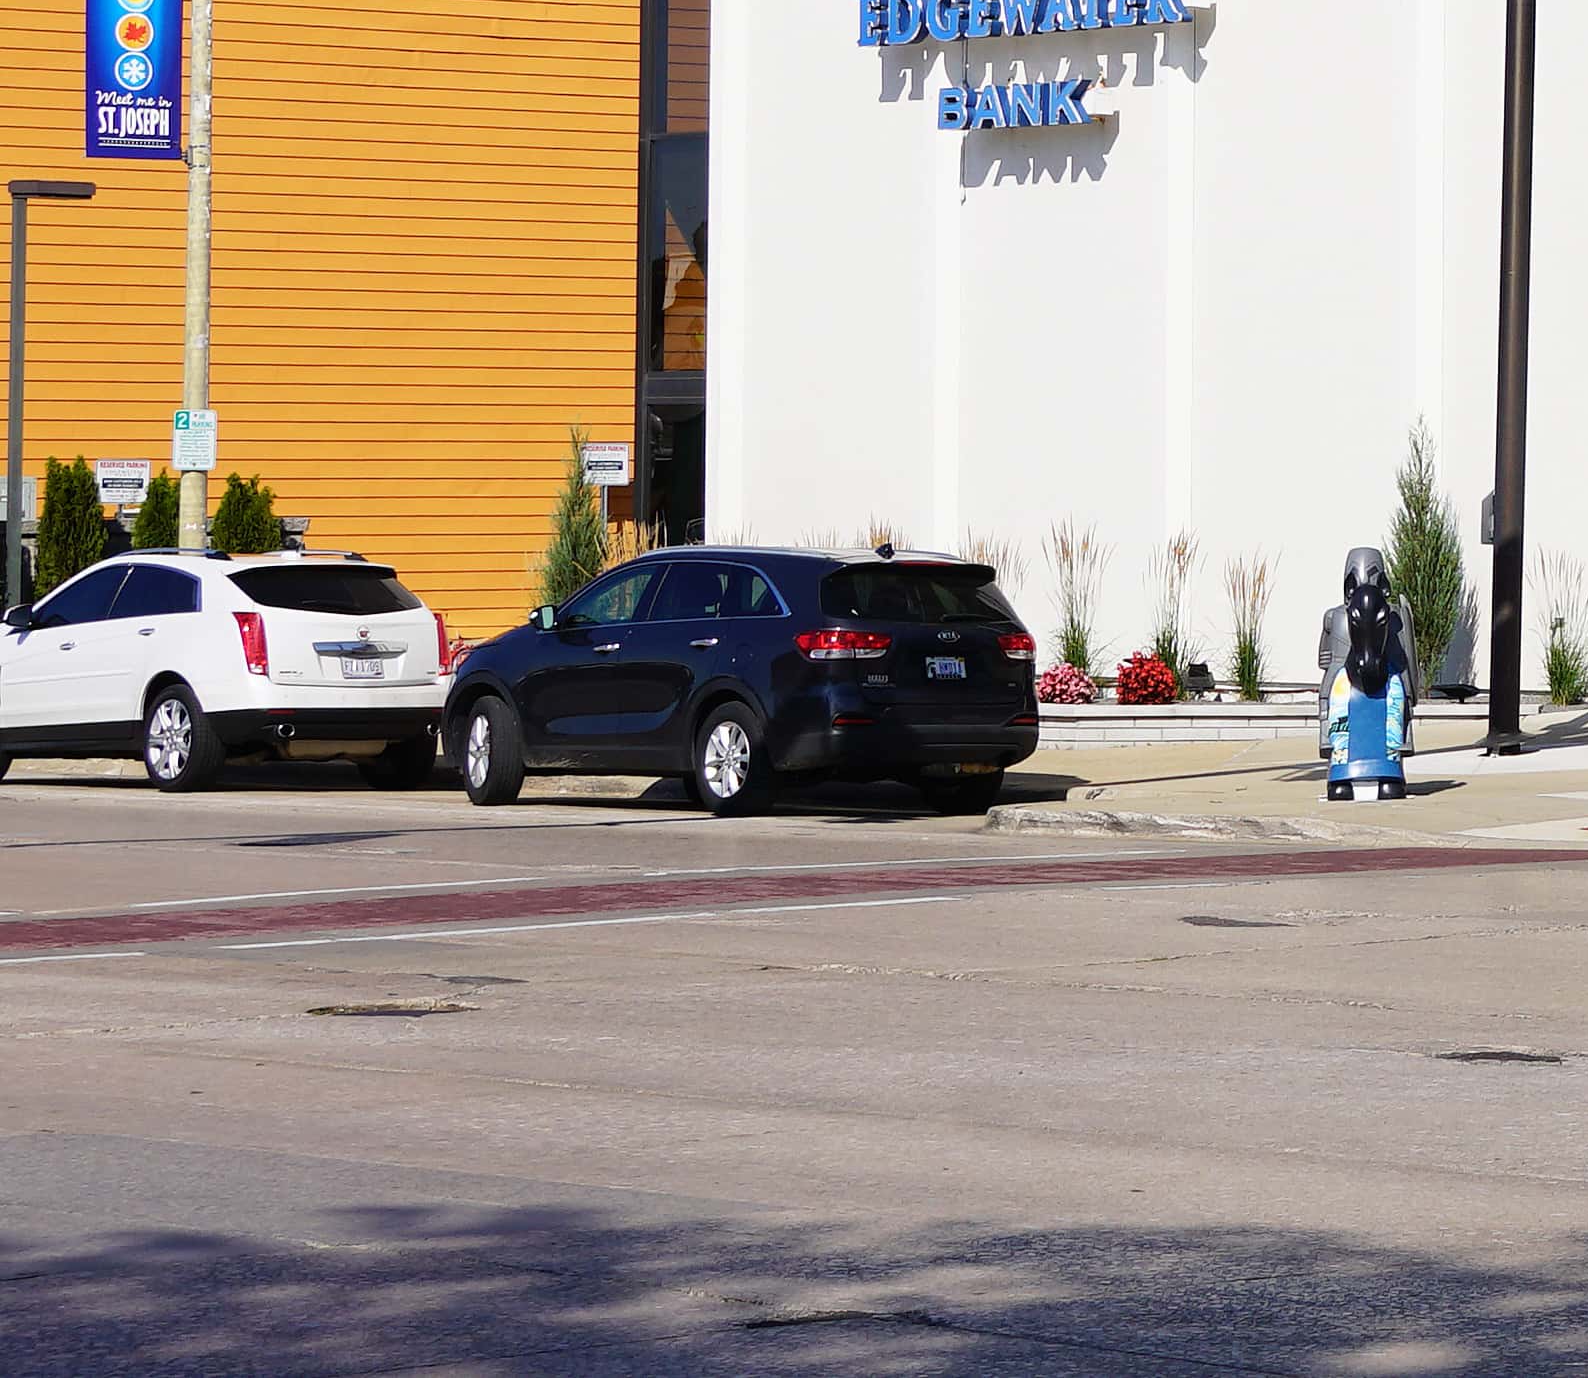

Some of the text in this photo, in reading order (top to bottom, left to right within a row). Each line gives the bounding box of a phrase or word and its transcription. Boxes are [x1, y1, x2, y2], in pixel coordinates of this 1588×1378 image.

[95, 90, 172, 108] Meet me in
[937, 79, 1093, 131] BANK
[177, 413, 188, 428] 2
